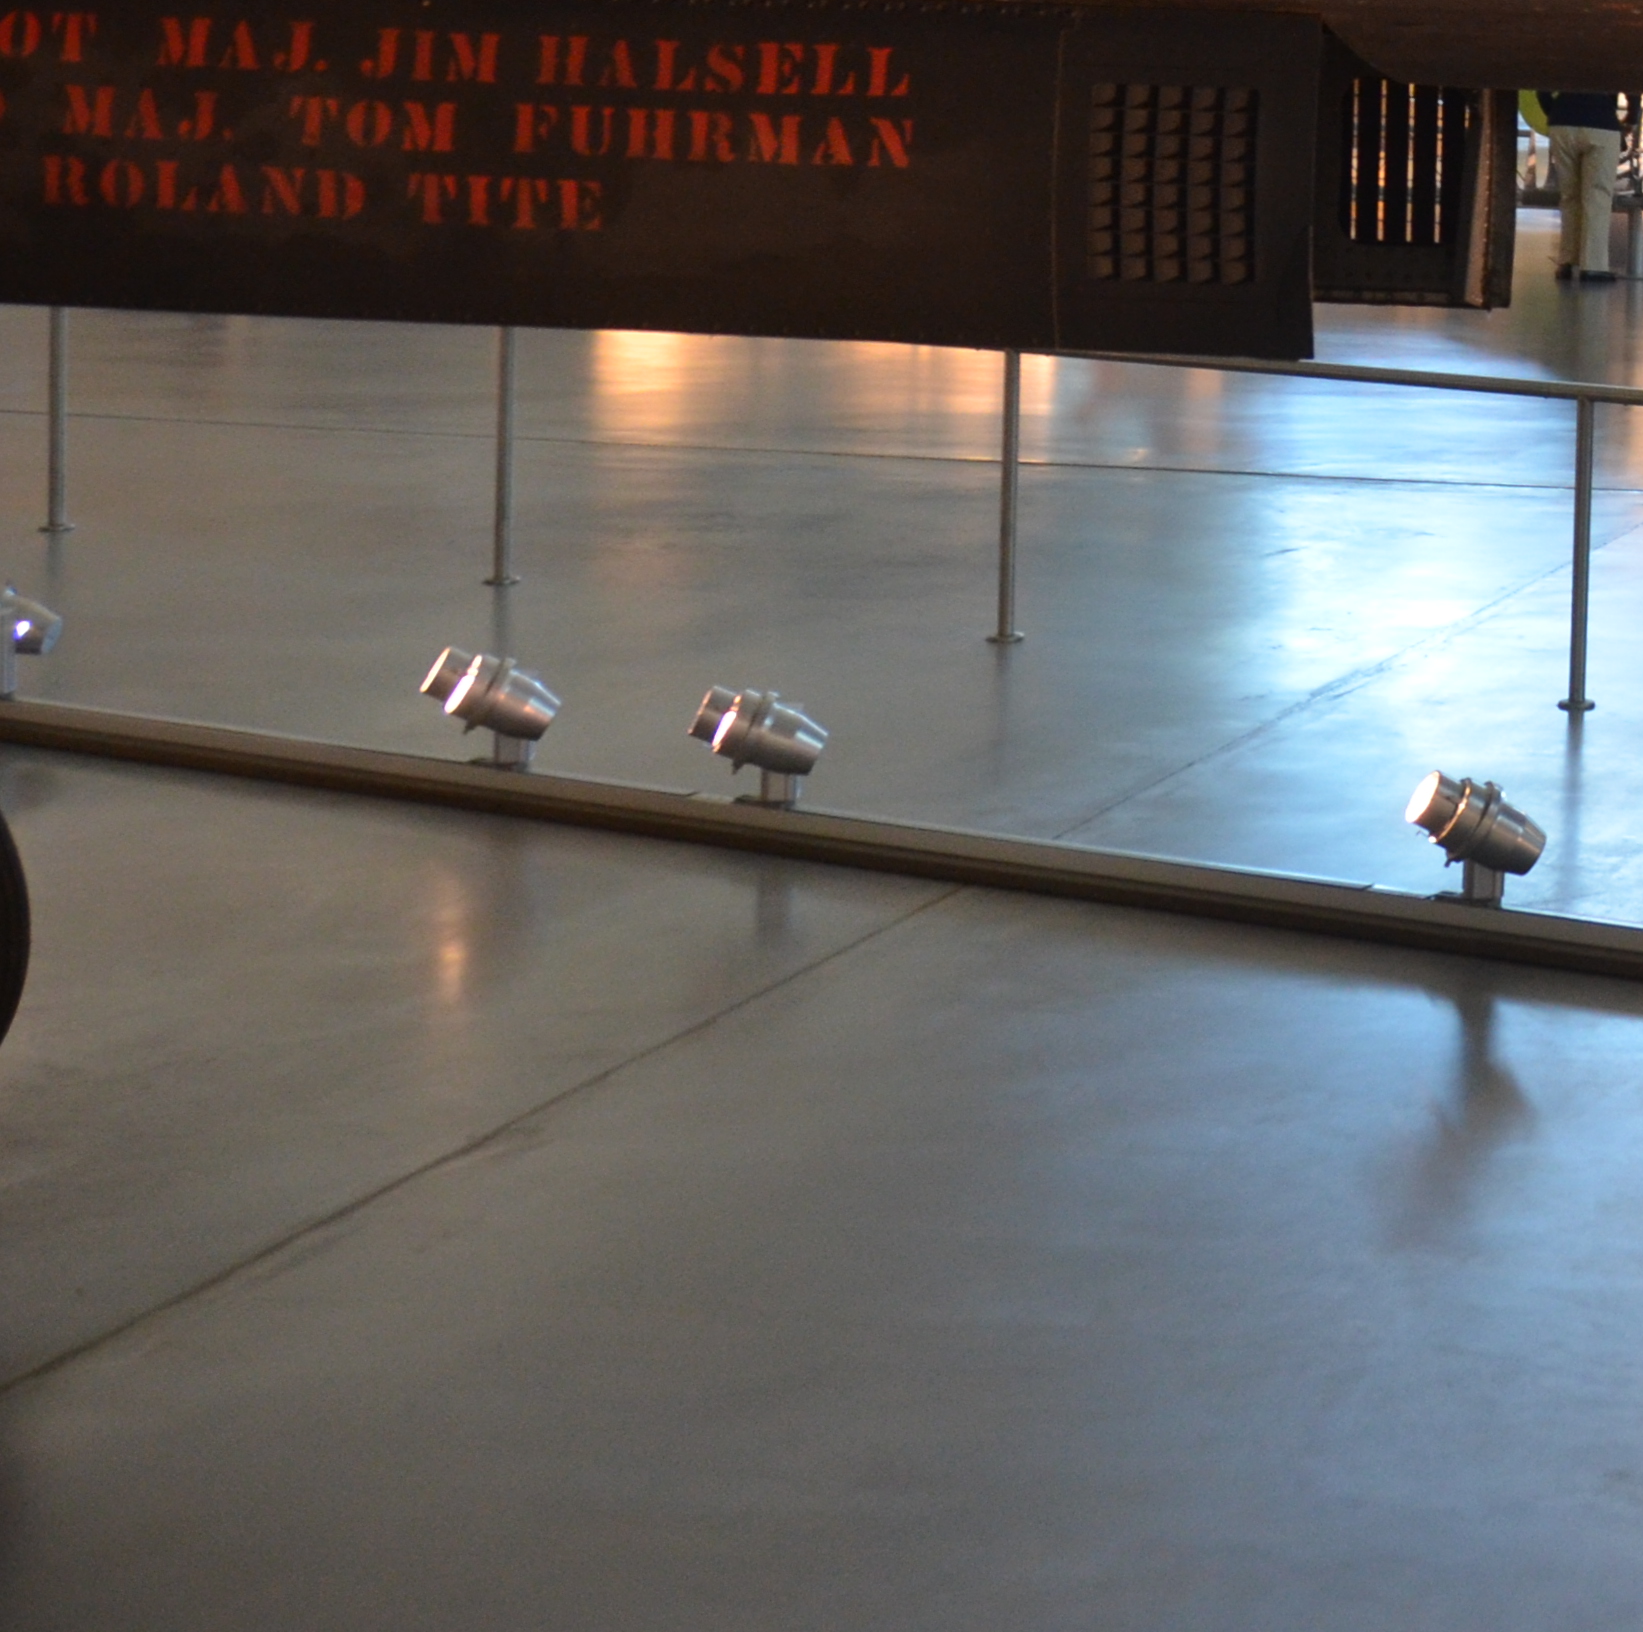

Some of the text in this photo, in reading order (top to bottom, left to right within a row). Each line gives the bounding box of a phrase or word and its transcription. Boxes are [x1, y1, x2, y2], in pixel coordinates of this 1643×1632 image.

[157, 16, 328, 70] MAJ.
[360, 27, 500, 84] JIM
[535, 34, 911, 97] HALSELL
[62, 84, 234, 141] MAJ.
[289, 95, 458, 153] TOM
[514, 102, 915, 168] FUHRMAN
[41, 153, 603, 231] ROLAND TITE
